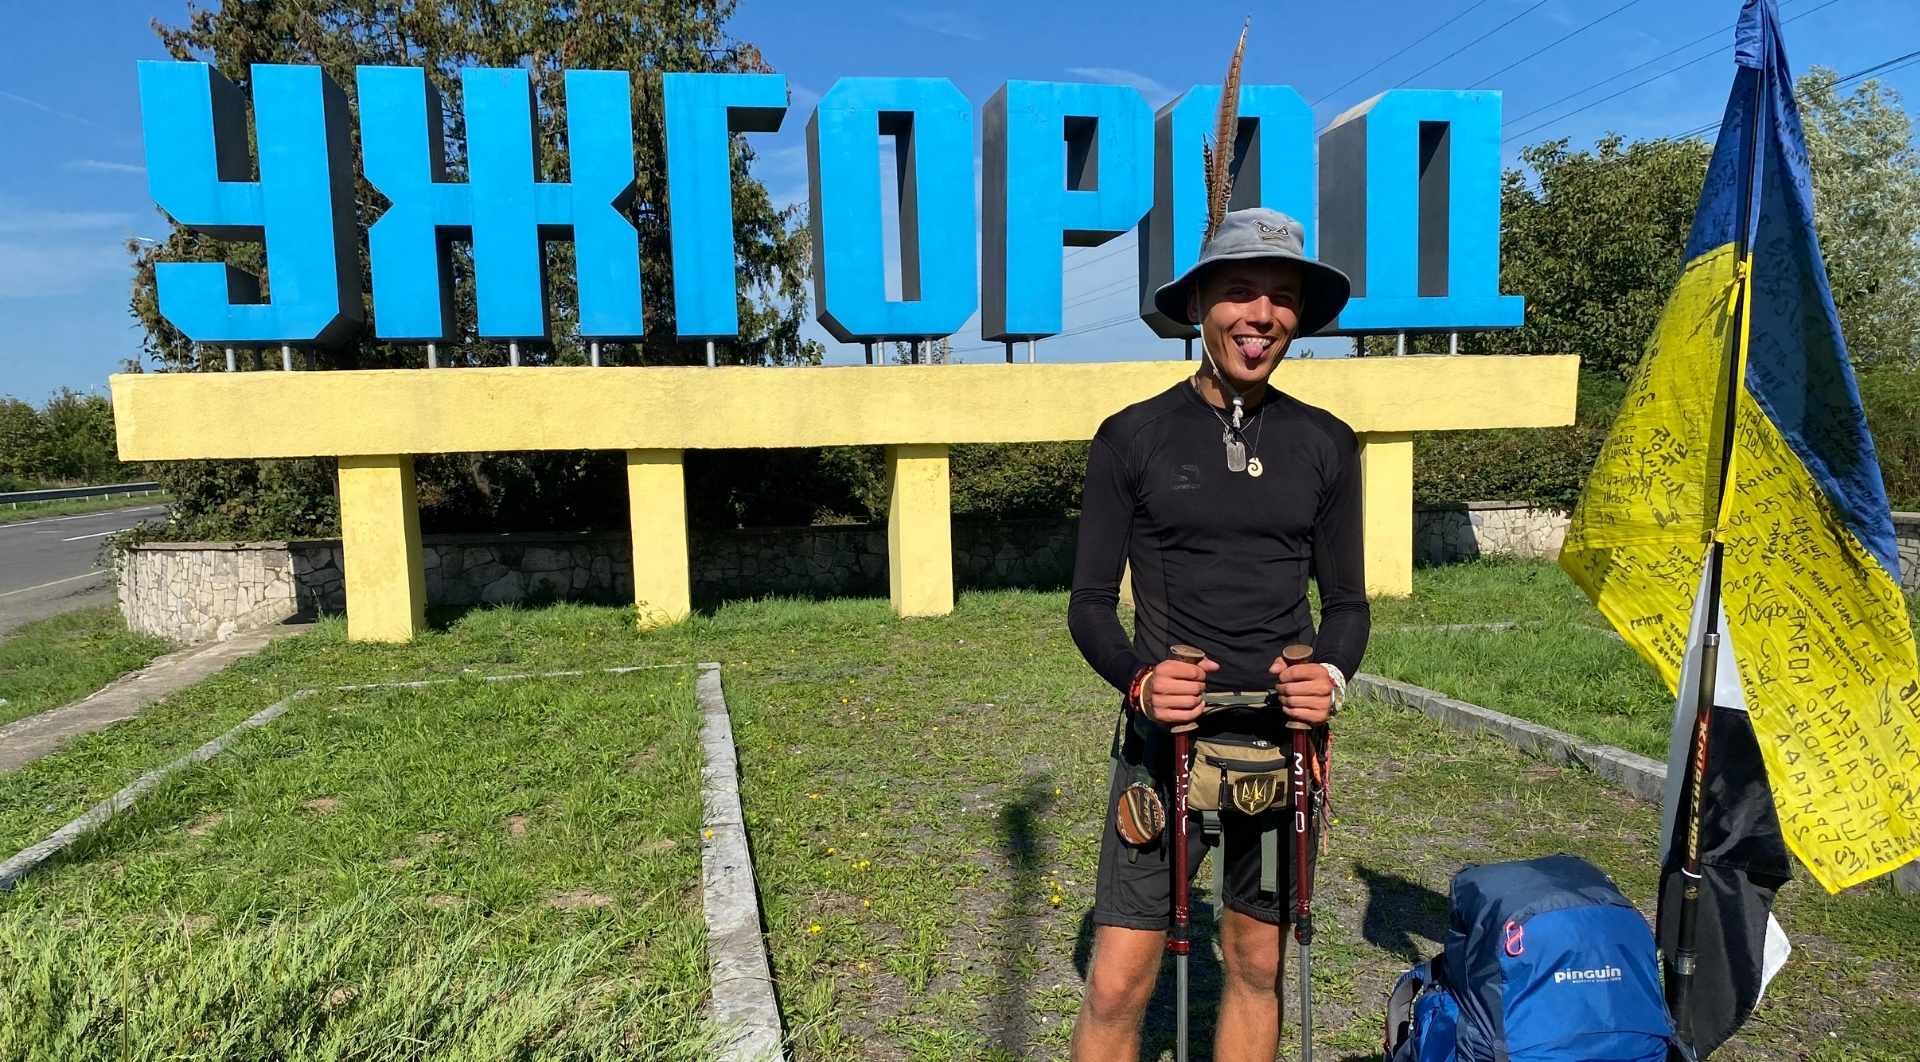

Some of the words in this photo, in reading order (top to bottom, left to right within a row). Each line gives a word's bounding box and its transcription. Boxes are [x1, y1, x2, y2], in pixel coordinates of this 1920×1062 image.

[137, 60, 1525, 343] УЖГОРОД
[1294, 752, 1305, 833] MILO
[1554, 965, 1622, 983] pinguin
